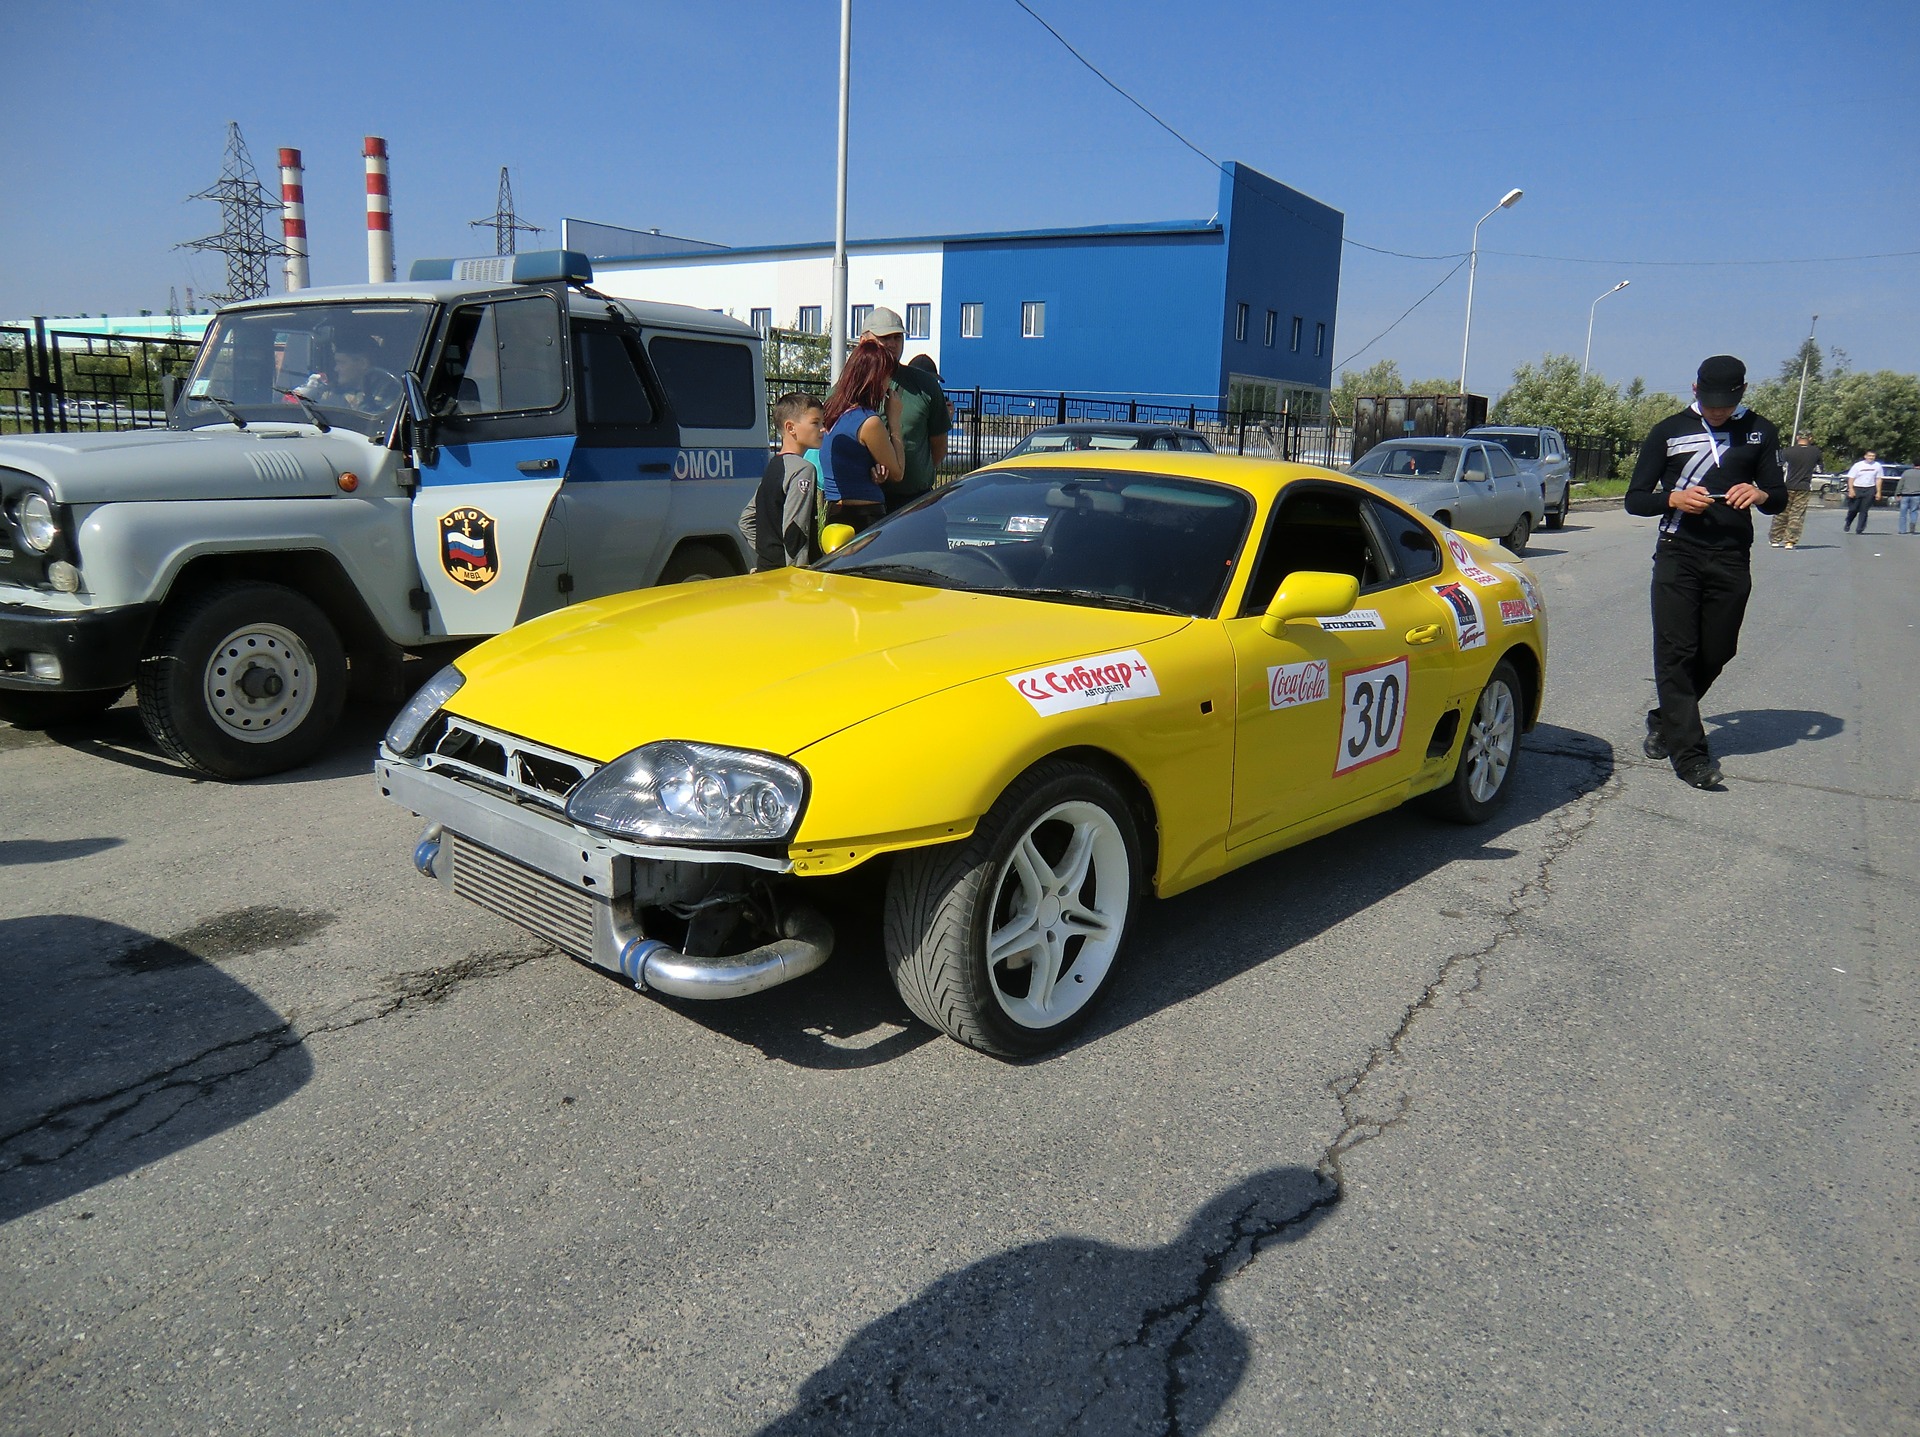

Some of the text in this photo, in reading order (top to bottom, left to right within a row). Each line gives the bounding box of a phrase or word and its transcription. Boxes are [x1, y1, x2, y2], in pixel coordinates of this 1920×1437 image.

[674, 450, 733, 479] ОМОН
[444, 511, 490, 528] ОМОН
[464, 571, 481, 580] МВД
[1321, 620, 1377, 630] HUMMER
[1084, 683, 1125, 698] АВТОЦЕНТР
[1347, 674, 1400, 758] 30
